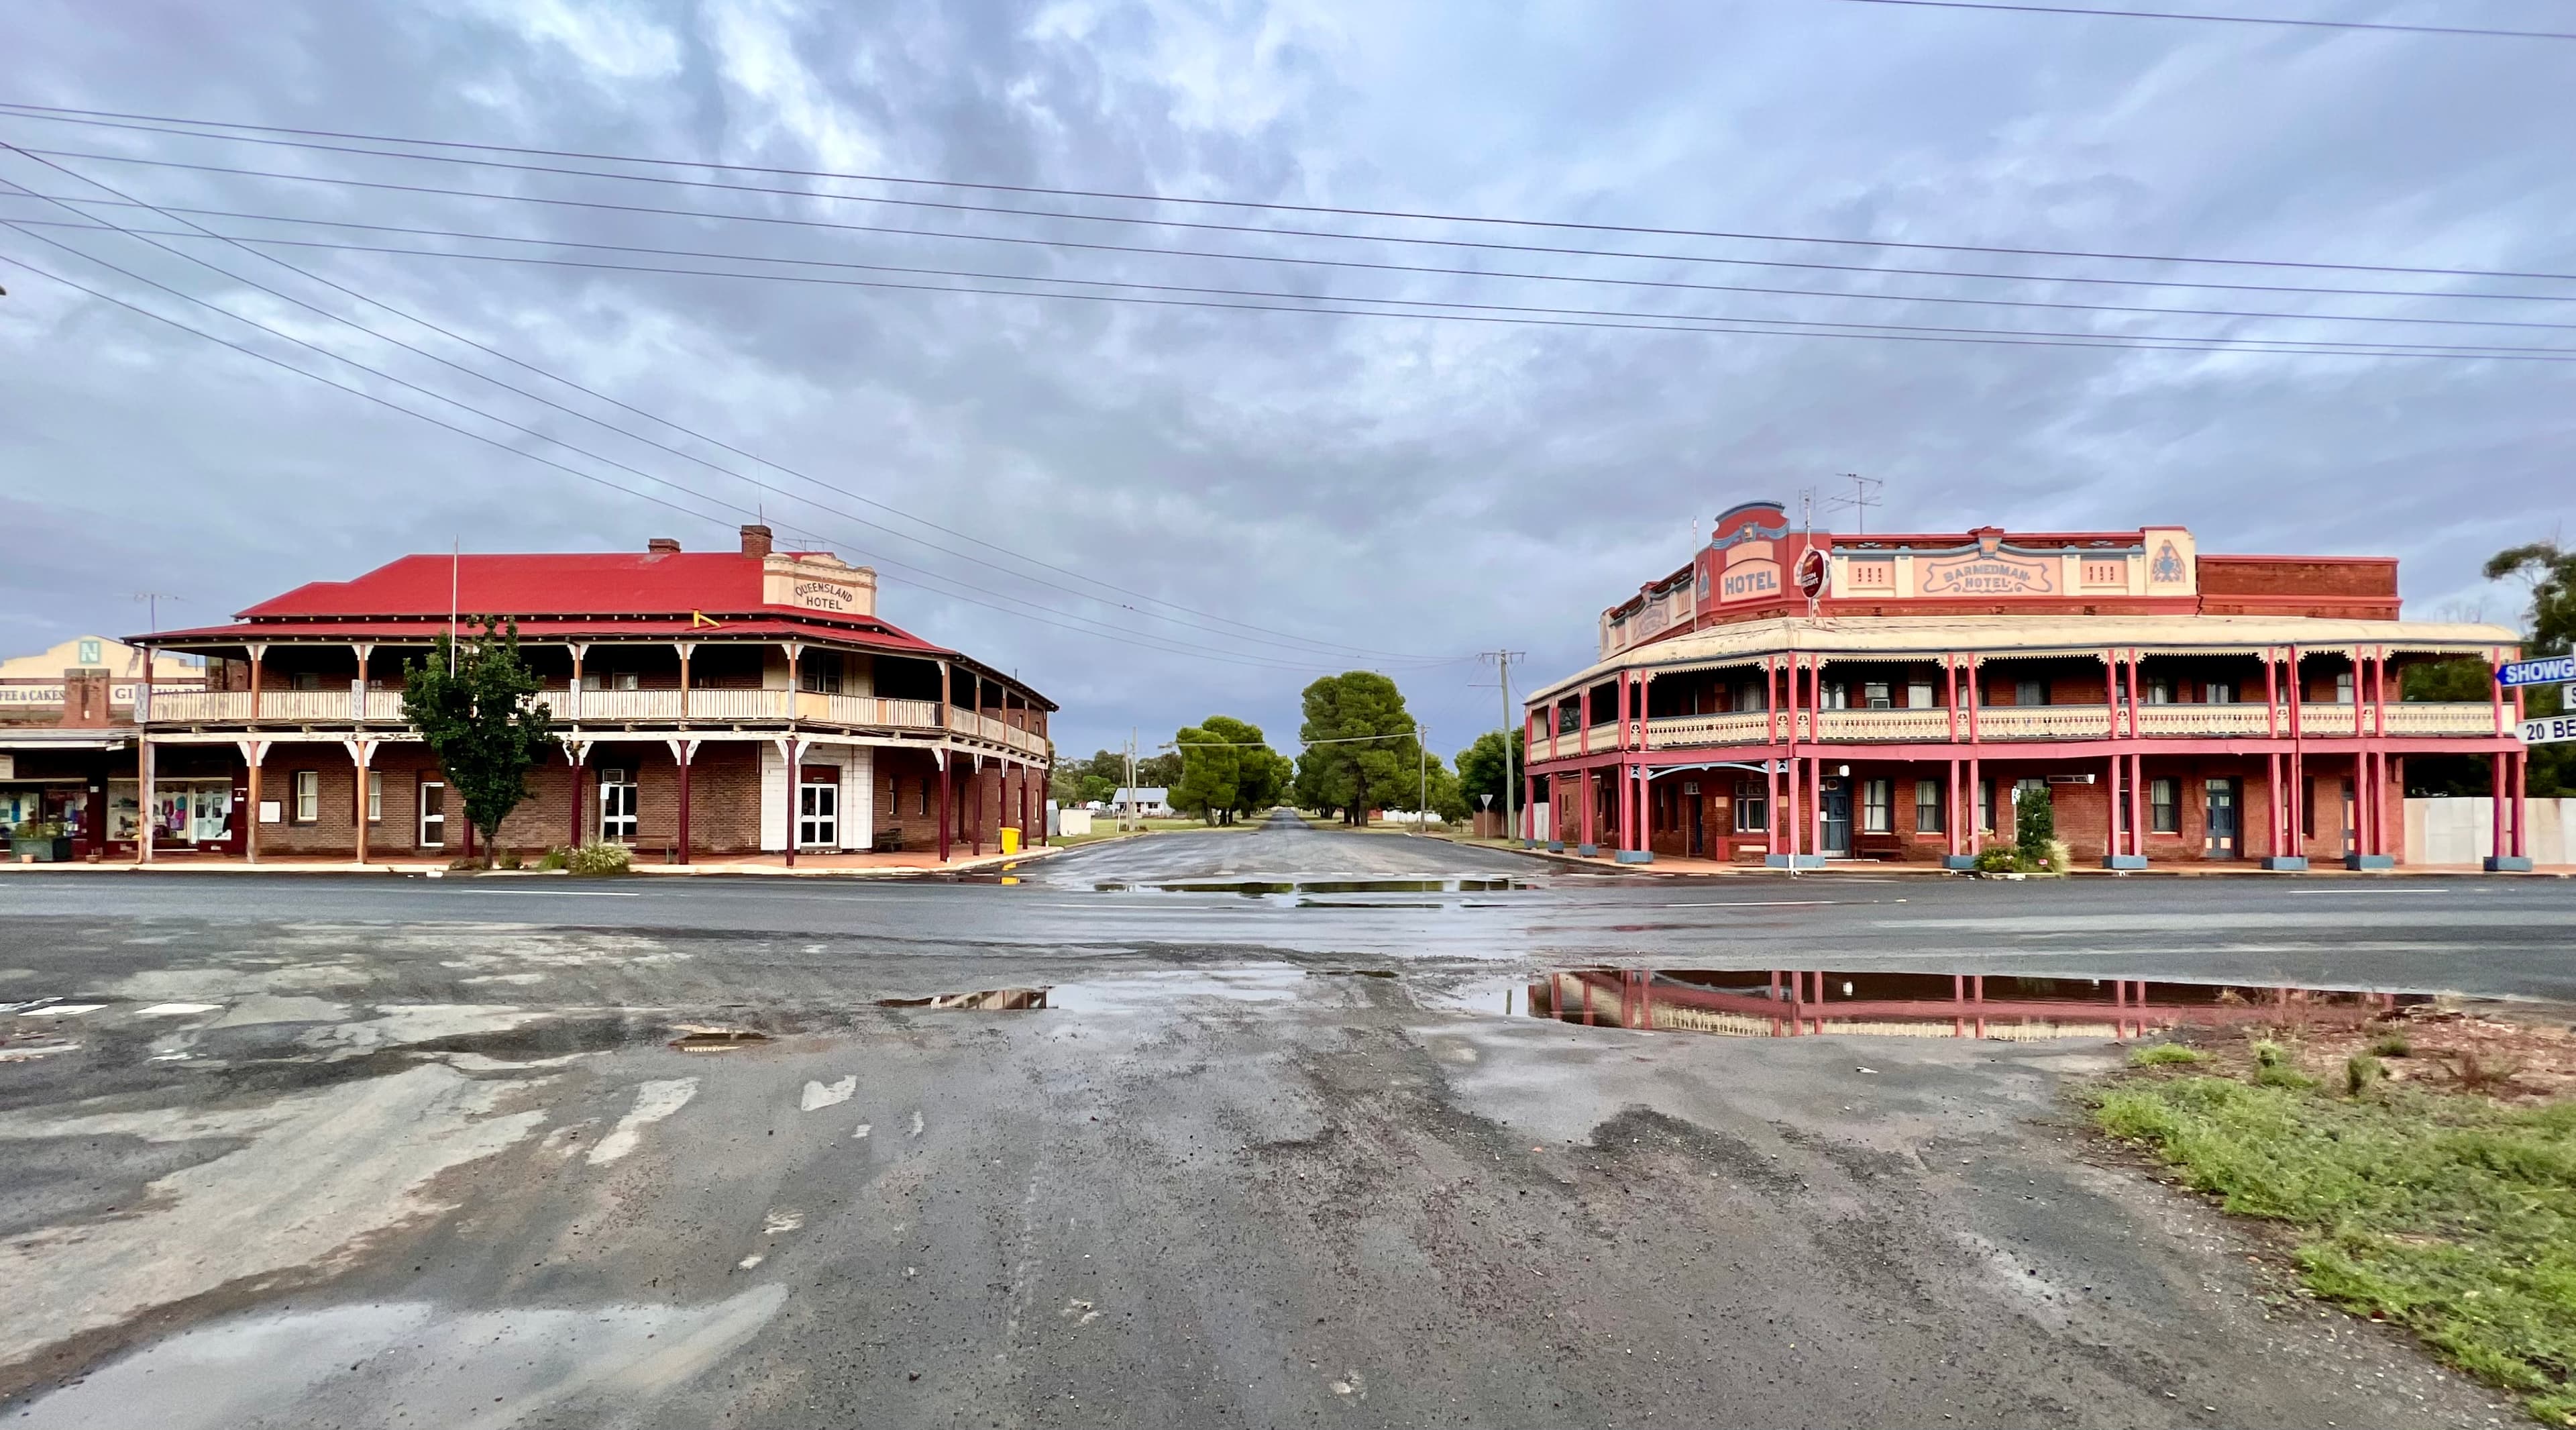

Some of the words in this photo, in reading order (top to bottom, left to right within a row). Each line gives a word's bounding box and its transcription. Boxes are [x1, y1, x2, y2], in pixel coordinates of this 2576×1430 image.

[1943, 564, 2029, 582] BARMEDMAN
[796, 582, 853, 603] QUEENSLAND
[1725, 571, 1777, 596] HOTEL
[1966, 577, 2008, 589] HOTEL
[806, 597, 843, 610] HOTEL
[80, 642, 99, 662] N
[29, 690, 65, 701] CAKES
[2526, 723, 2544, 741] 20
[2553, 719, 2576, 738] BE
